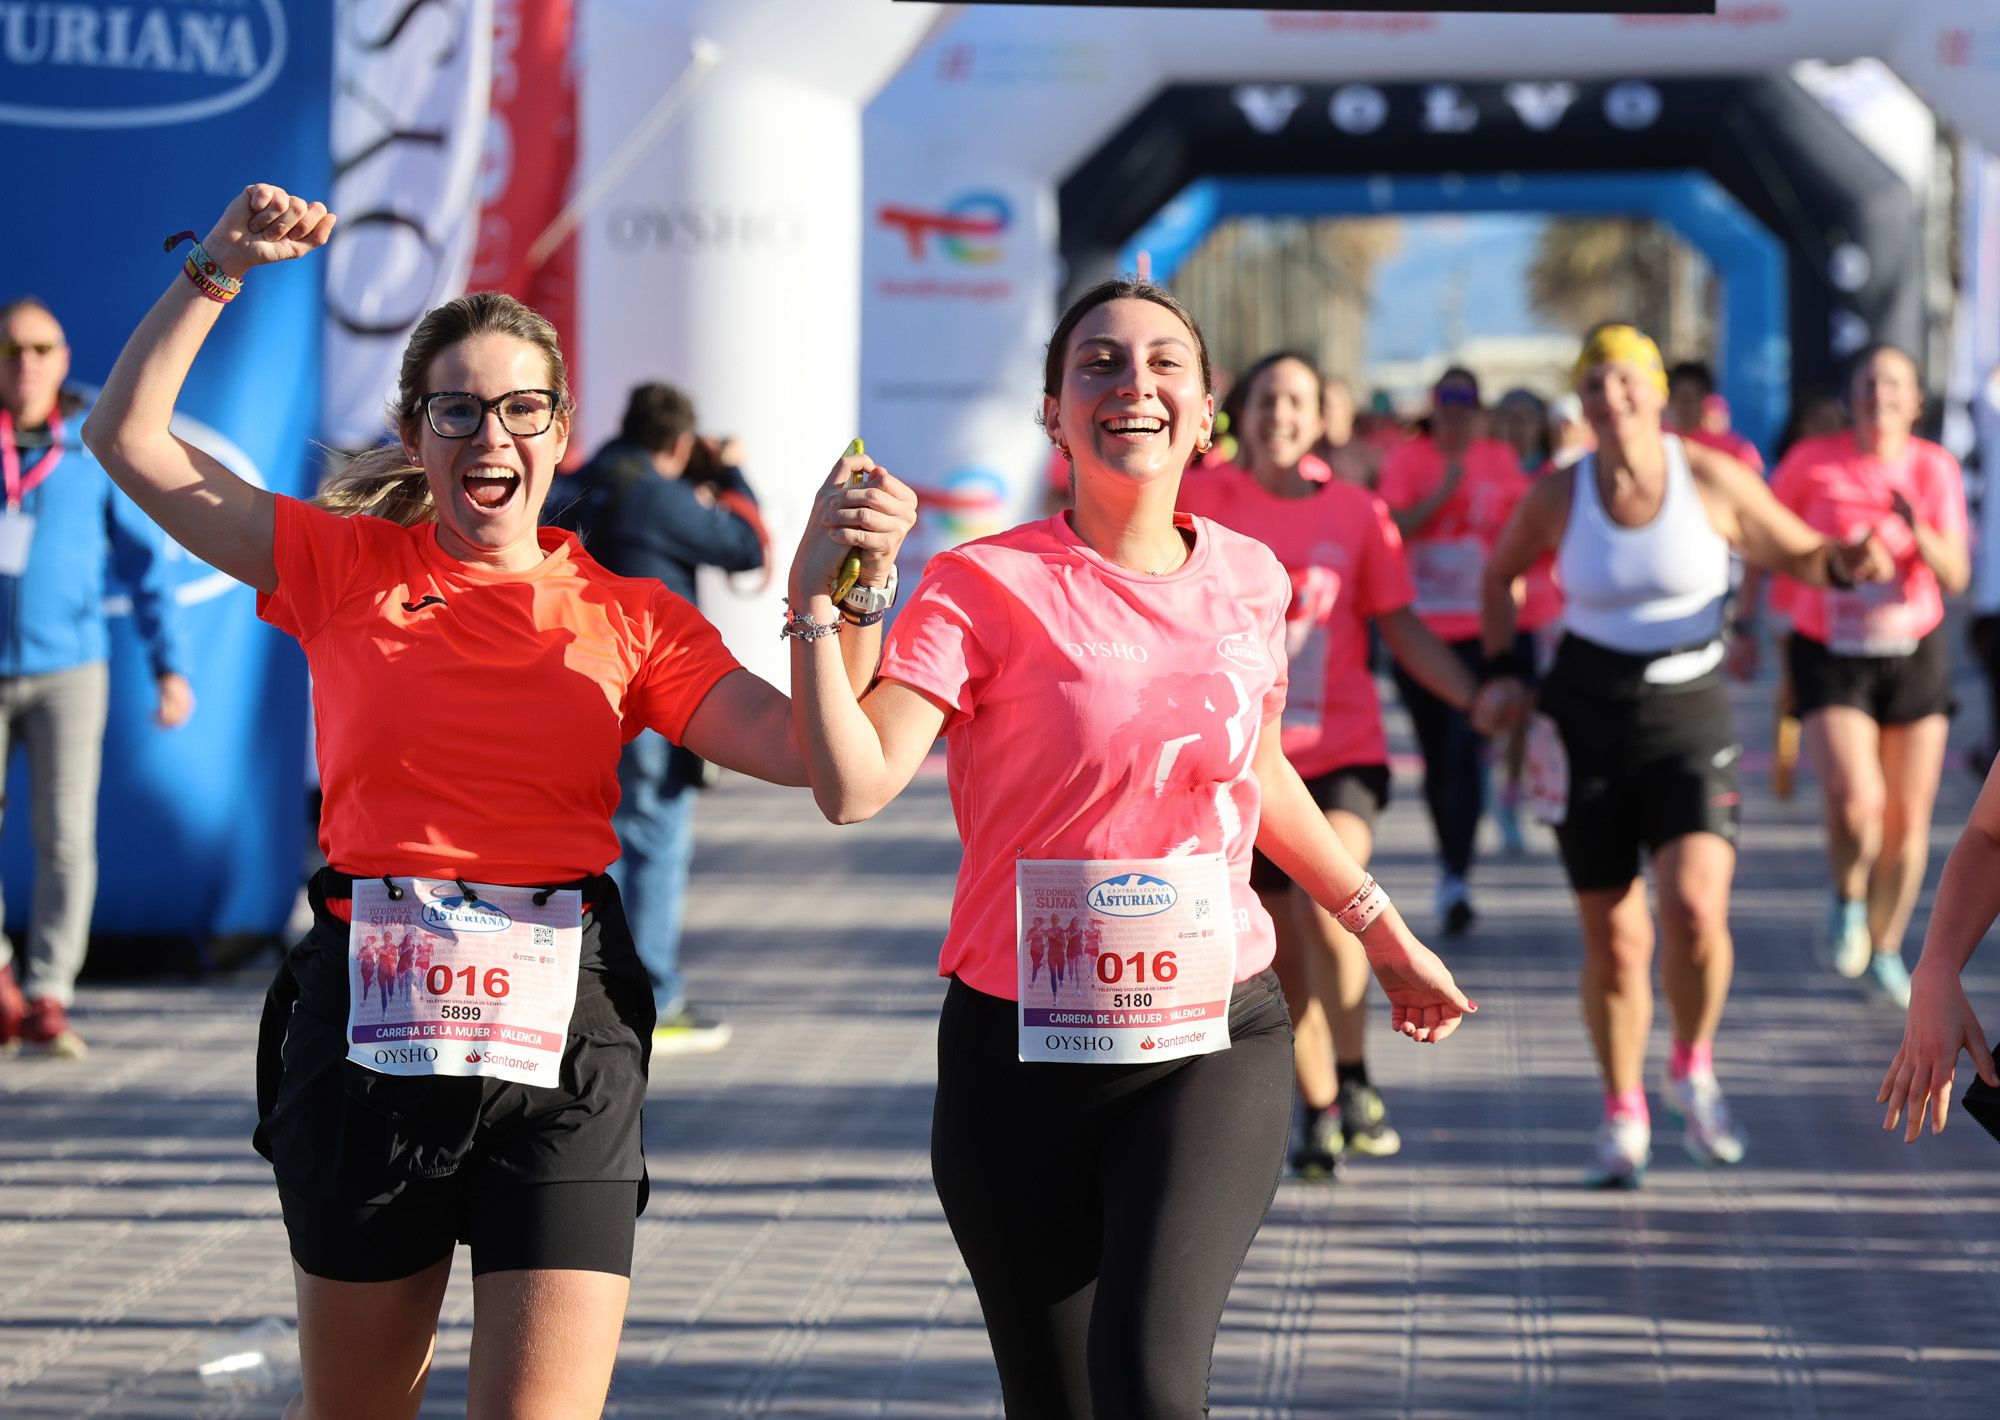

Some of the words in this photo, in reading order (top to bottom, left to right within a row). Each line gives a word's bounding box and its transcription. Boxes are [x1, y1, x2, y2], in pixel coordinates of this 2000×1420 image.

[0, 3, 260, 77] URIANA
[1233, 80, 1665, 136] VOLVO
[1065, 642, 1148, 663] OYSHO
[1046, 889, 1077, 897] DORSAL
[1093, 890, 1171, 907] ASTURIANA
[381, 907, 412, 915] DORSAL
[1036, 897, 1078, 909] SUMA
[370, 915, 412, 927] SUMA
[428, 906, 505, 926] ASTURIANA
[1096, 950, 1178, 984] 016
[426, 964, 511, 998] 016
[1113, 993, 1153, 1008] 5180
[441, 1005, 481, 1020] 5899
[1049, 1013, 1094, 1024] CARRERA
[1097, 1014, 1110, 1025] DE
[1112, 1014, 1126, 1025] LA
[1129, 1013, 1162, 1024] MUJER
[1169, 1007, 1206, 1021] VALENCIA
[376, 1025, 420, 1039] CARRERA
[423, 1025, 436, 1036] DE
[439, 1025, 451, 1036] LA
[455, 1026, 490, 1037] MUJER
[500, 1028, 542, 1045] VALENCIA
[1046, 1034, 1113, 1051] OYSHO
[1157, 1031, 1206, 1049] Santander
[374, 1046, 438, 1065] OYSHO
[483, 1051, 539, 1071] Santander
